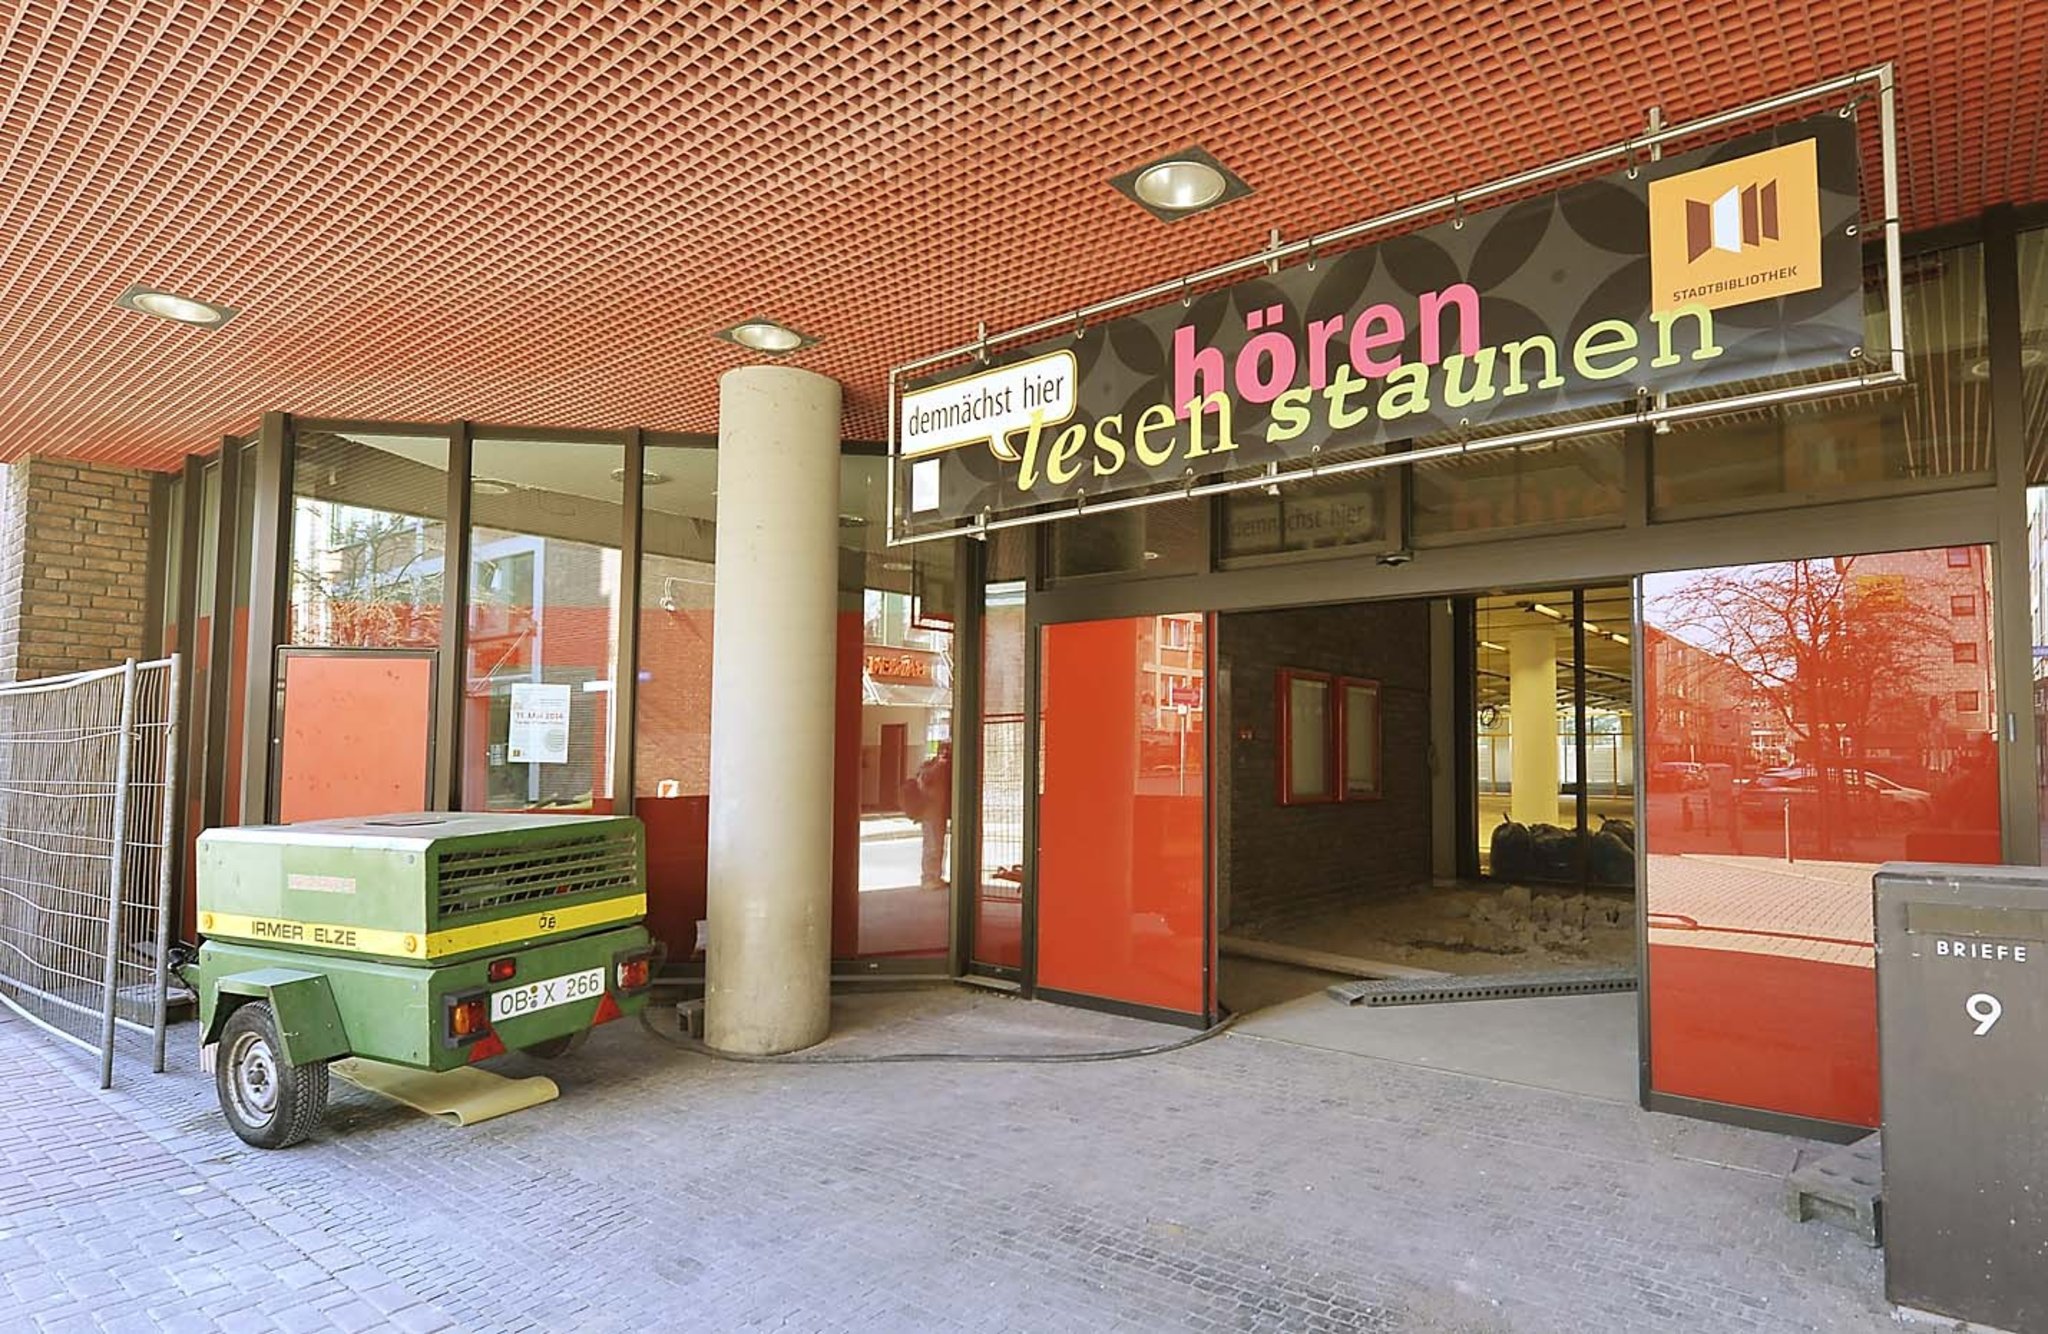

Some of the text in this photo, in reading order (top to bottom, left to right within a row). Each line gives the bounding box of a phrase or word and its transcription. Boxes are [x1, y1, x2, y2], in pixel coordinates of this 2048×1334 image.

[1672, 264, 1798, 302] STADTBIBLIOTHEK
[1173, 282, 1481, 421] hören
[908, 373, 1065, 437] demnächst hier
[1016, 303, 1724, 492] lesen staunen
[251, 920, 357, 947] IRMER ELZE
[1936, 940, 2026, 963] BRIEFE
[500, 972, 600, 1016] OB X 266
[1965, 993, 2002, 1036] 9
